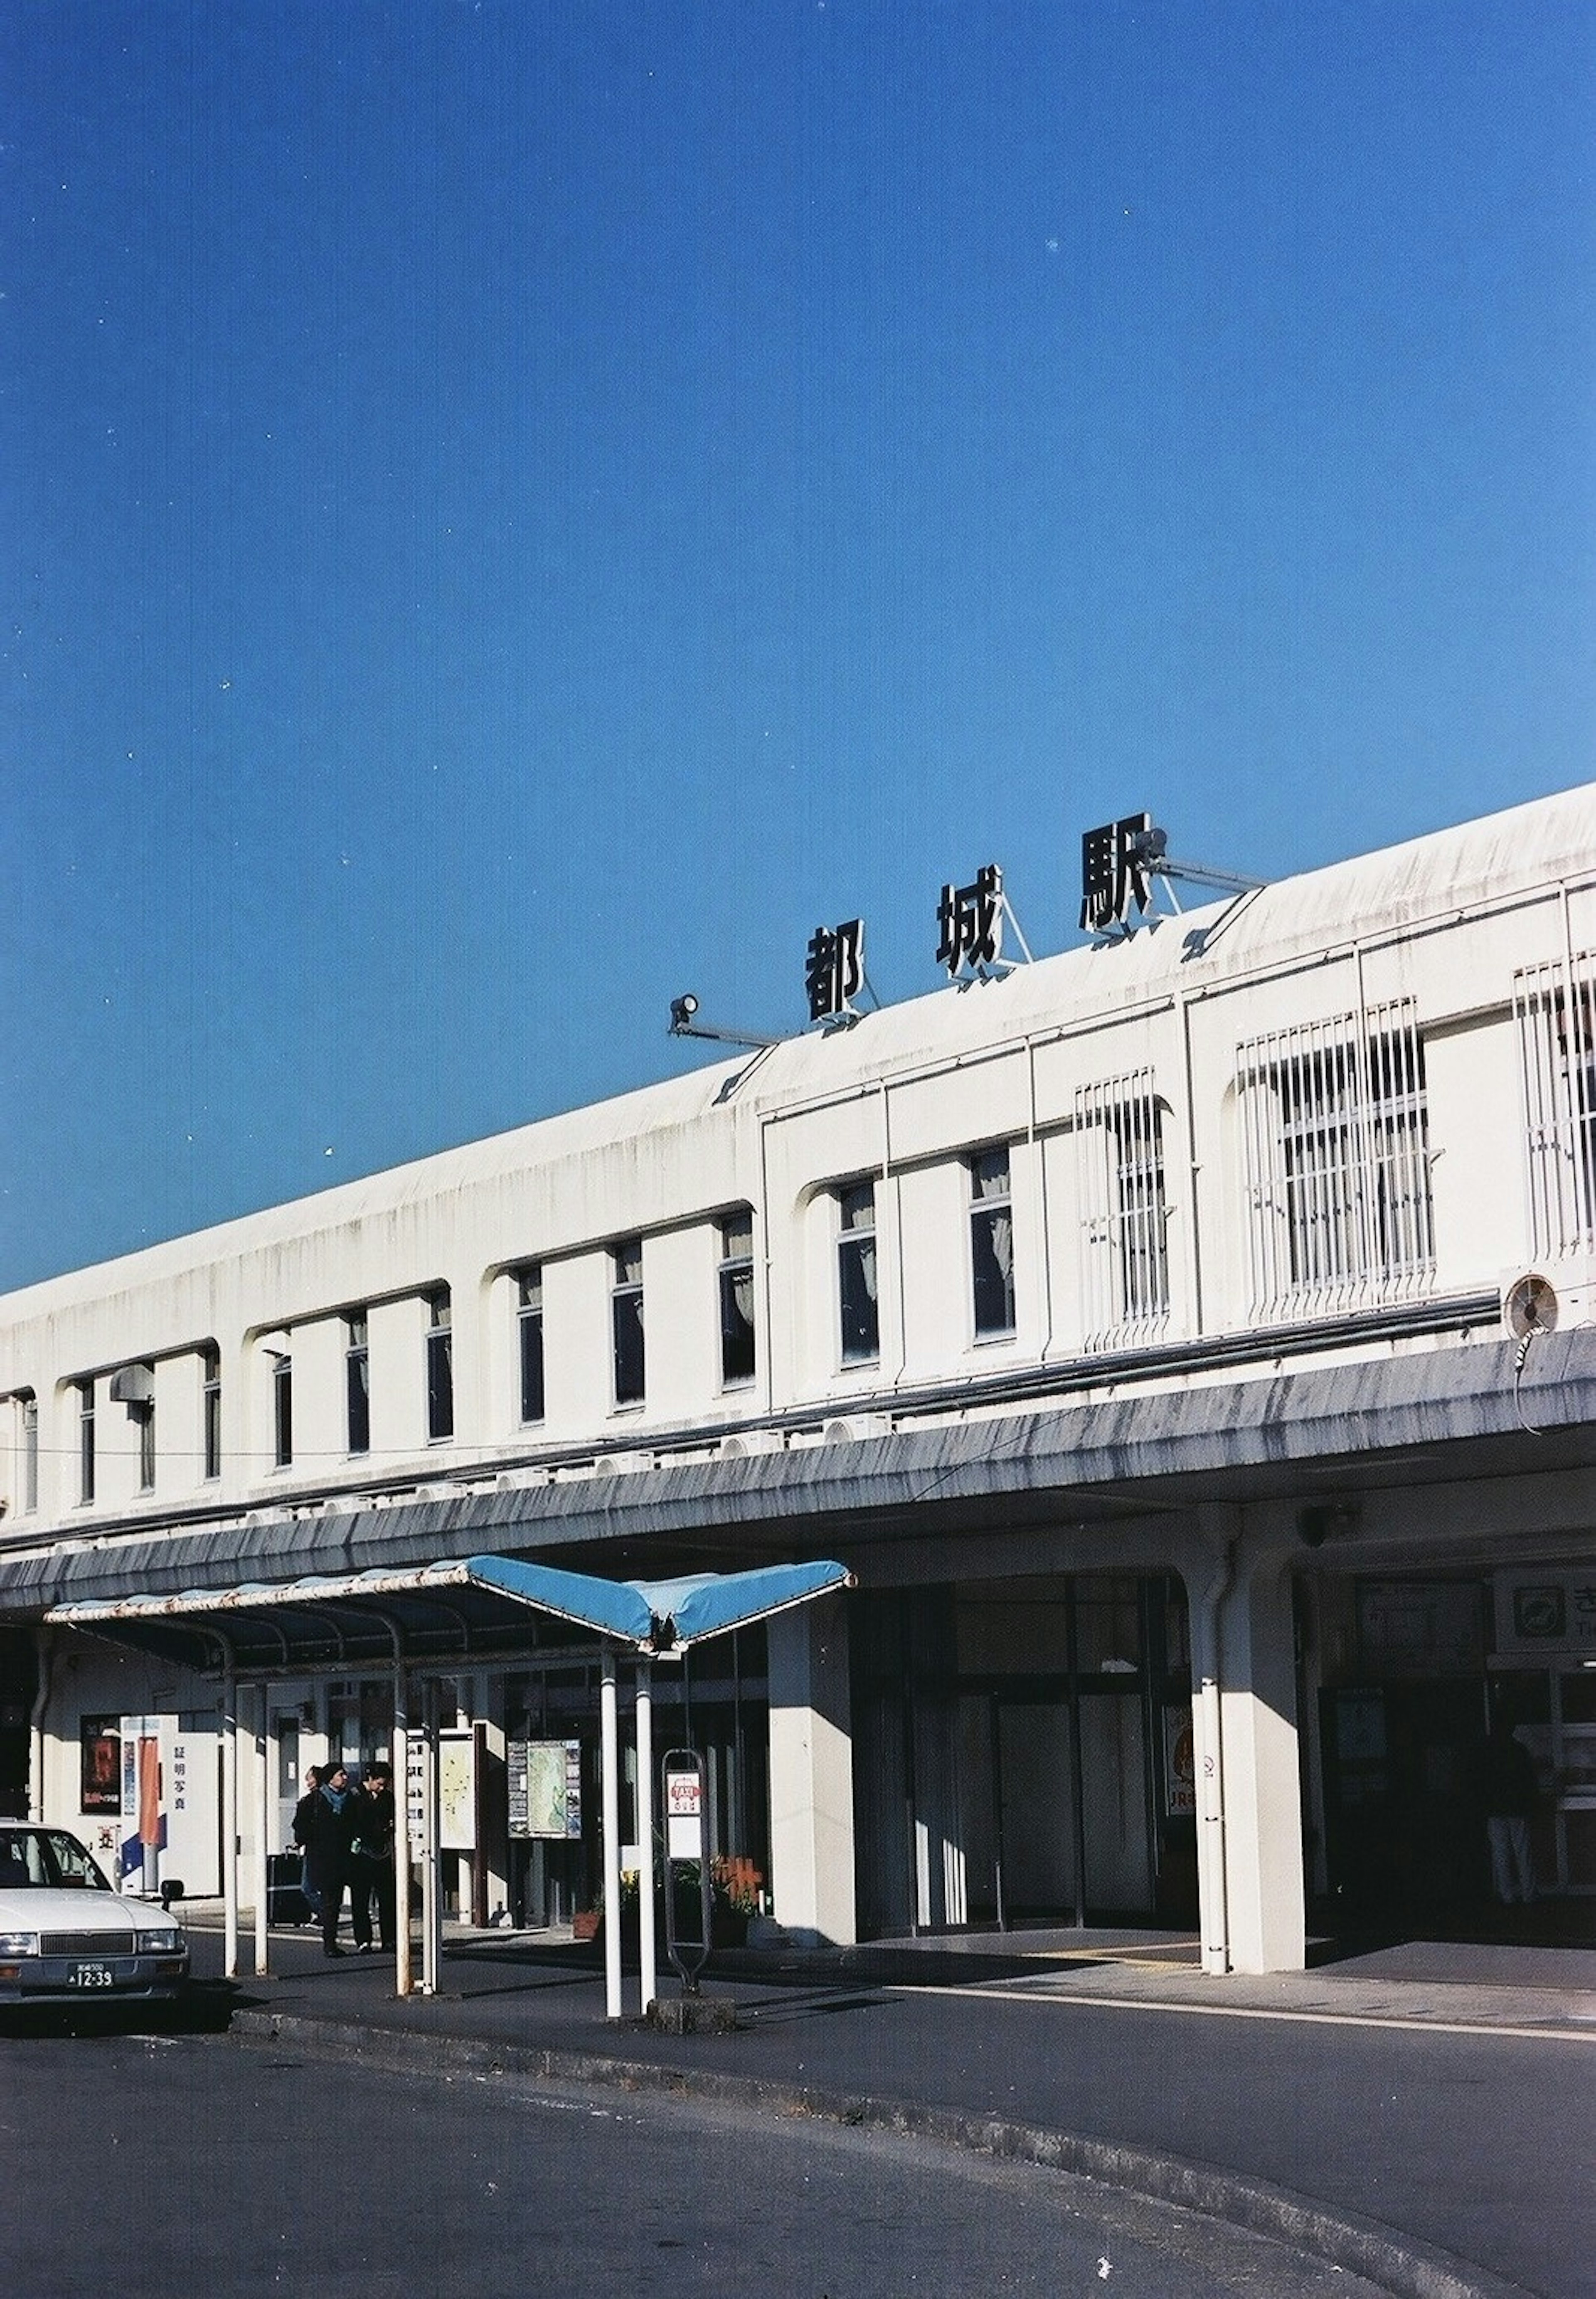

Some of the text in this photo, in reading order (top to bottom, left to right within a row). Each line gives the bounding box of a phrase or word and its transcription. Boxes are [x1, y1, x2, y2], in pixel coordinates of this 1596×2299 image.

[805, 813, 1152, 1022] 都城駅
[175, 1746, 185, 1810] 証明写真
[674, 1786, 694, 1796] TAXI
[78, 1971, 112, 1986] 12-39
